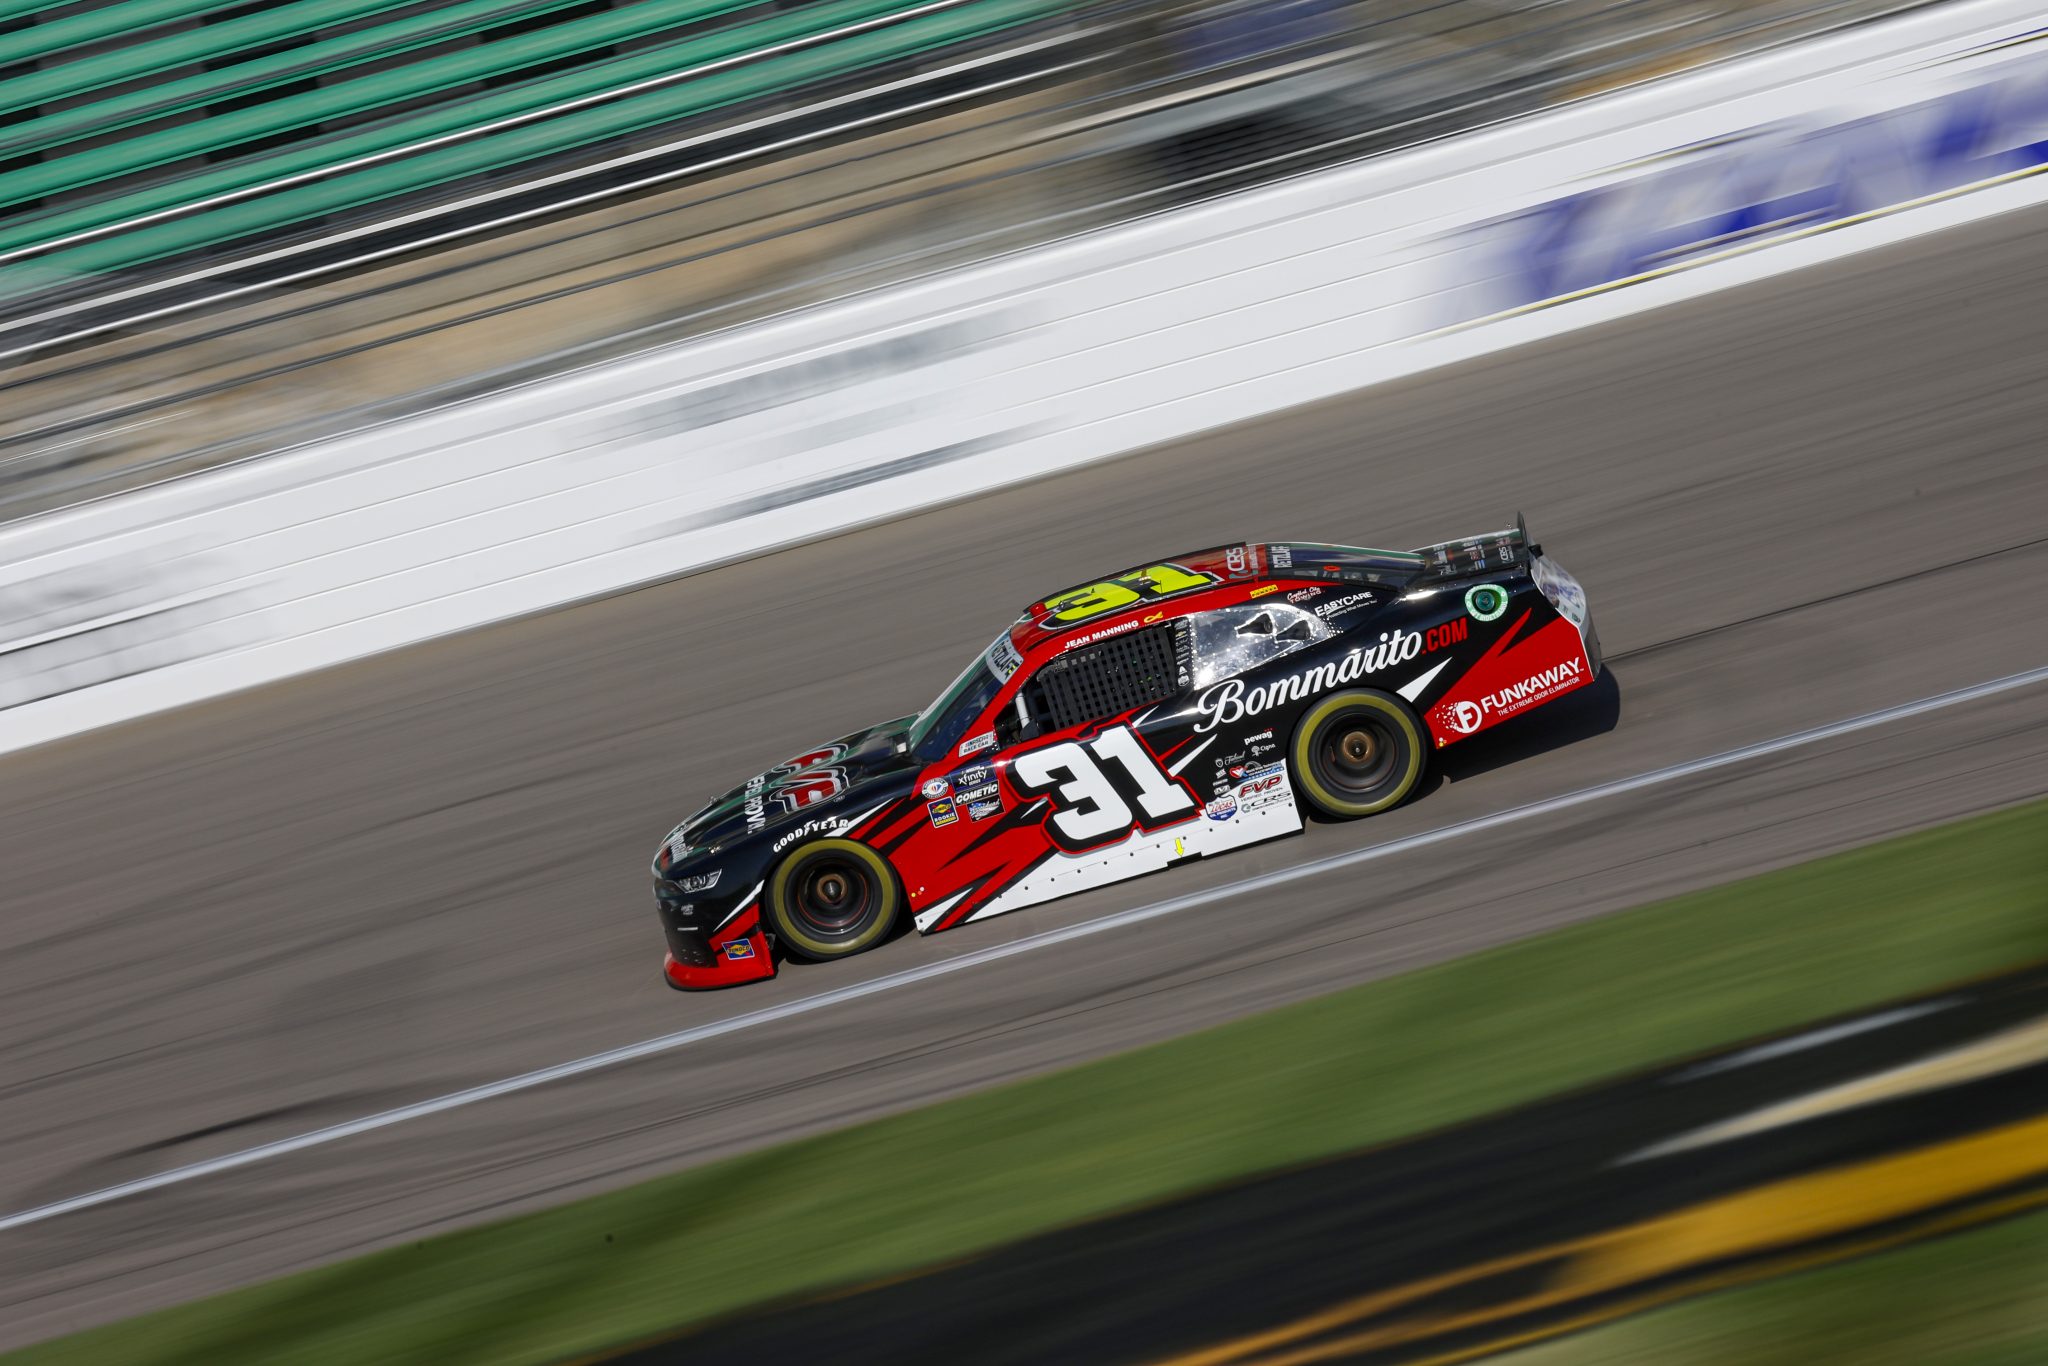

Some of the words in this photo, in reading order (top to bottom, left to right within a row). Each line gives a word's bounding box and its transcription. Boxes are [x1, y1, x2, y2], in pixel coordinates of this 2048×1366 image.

[1314, 591, 1373, 617] EASYCARE
[1065, 635, 1090, 649] JEAN
[1092, 620, 1139, 640] MANNING
[1481, 657, 1580, 714] FUNKAWAY
[1498, 708, 1509, 717] THE
[1509, 697, 1534, 712] EXTREME
[1534, 690, 1549, 701] ODOR
[1548, 677, 1581, 695] ELIMINATOR
[1244, 730, 1273, 746] pewag
[958, 769, 987, 785] xfinity
[1015, 725, 1195, 840] 31
[1238, 774, 1283, 798] FVP
[773, 818, 849, 853] GOODYEAR
